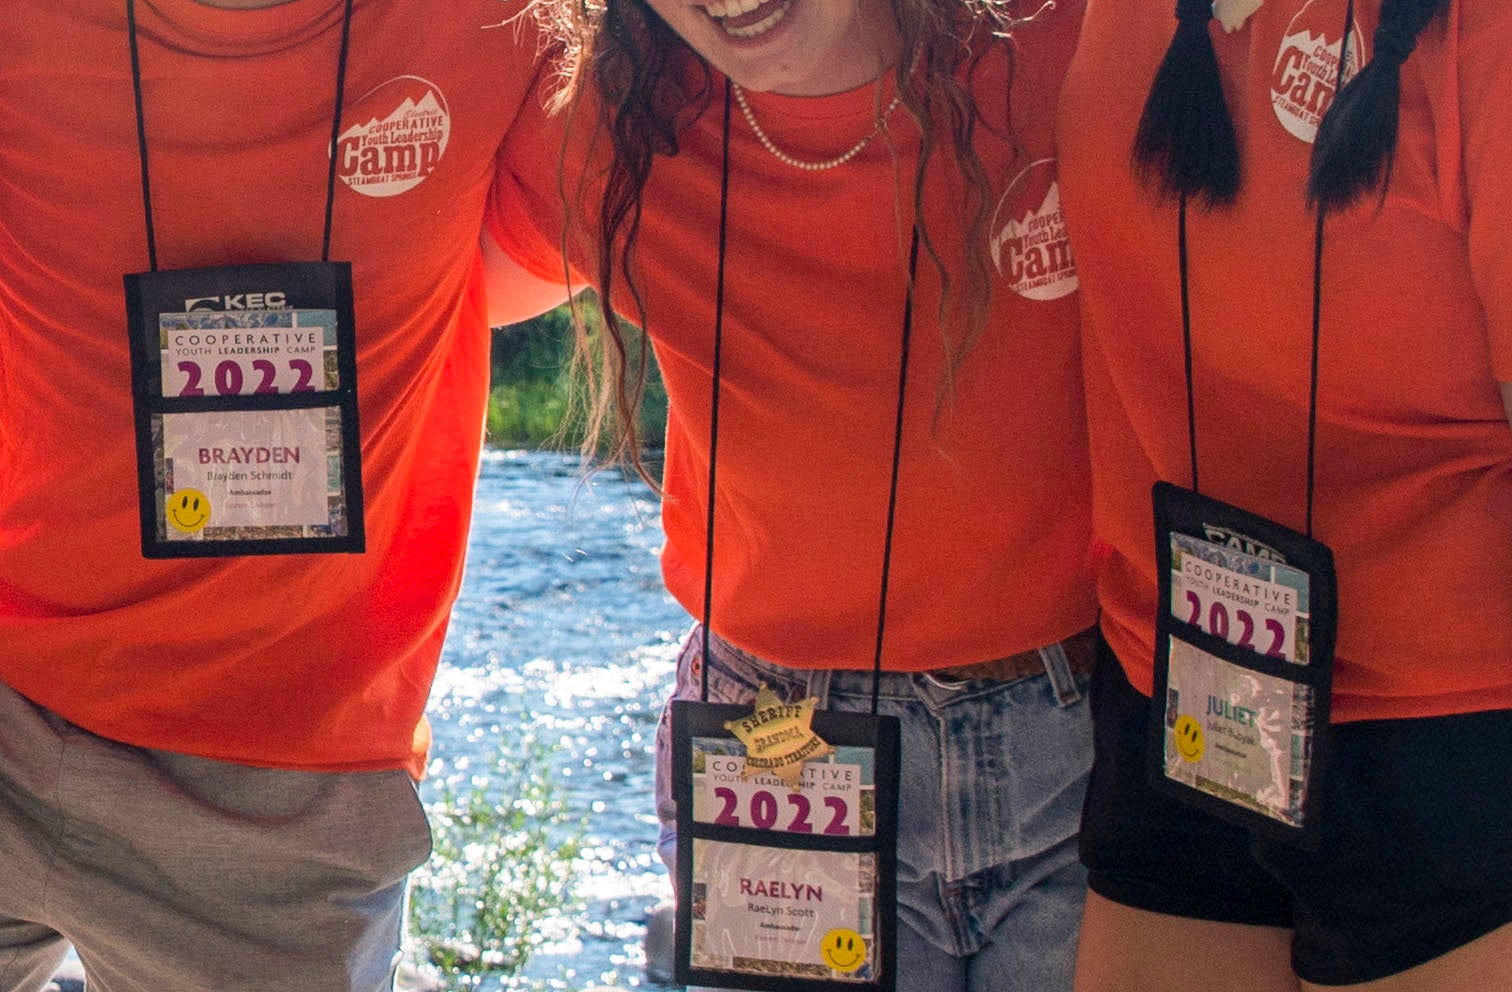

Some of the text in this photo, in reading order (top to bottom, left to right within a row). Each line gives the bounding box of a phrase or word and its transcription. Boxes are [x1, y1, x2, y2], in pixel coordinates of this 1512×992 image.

[361, 127, 444, 146] Youth Leadership
[369, 115, 444, 134] COOPERATIVE
[337, 136, 440, 176] Camp
[225, 292, 287, 309] KEC
[175, 333, 316, 346] COOPERATIVE
[176, 346, 316, 356] YOUTH LEADERSHIP CAMP
[177, 359, 316, 396] 2022
[198, 447, 300, 464] BRAYDEN
[1185, 561, 1291, 606] COOPERATIVE
[1212, 587, 1260, 607] LEADERSHIP
[1264, 603, 1291, 615] CAMP
[1185, 590, 1287, 659] 2022
[742, 705, 803, 733] SHERIFF
[1206, 695, 1257, 729] JULIET
[823, 782, 852, 792] CAMP
[714, 787, 850, 836] 2022
[739, 878, 823, 903] RAELYN
[786, 906, 815, 918] Scott
